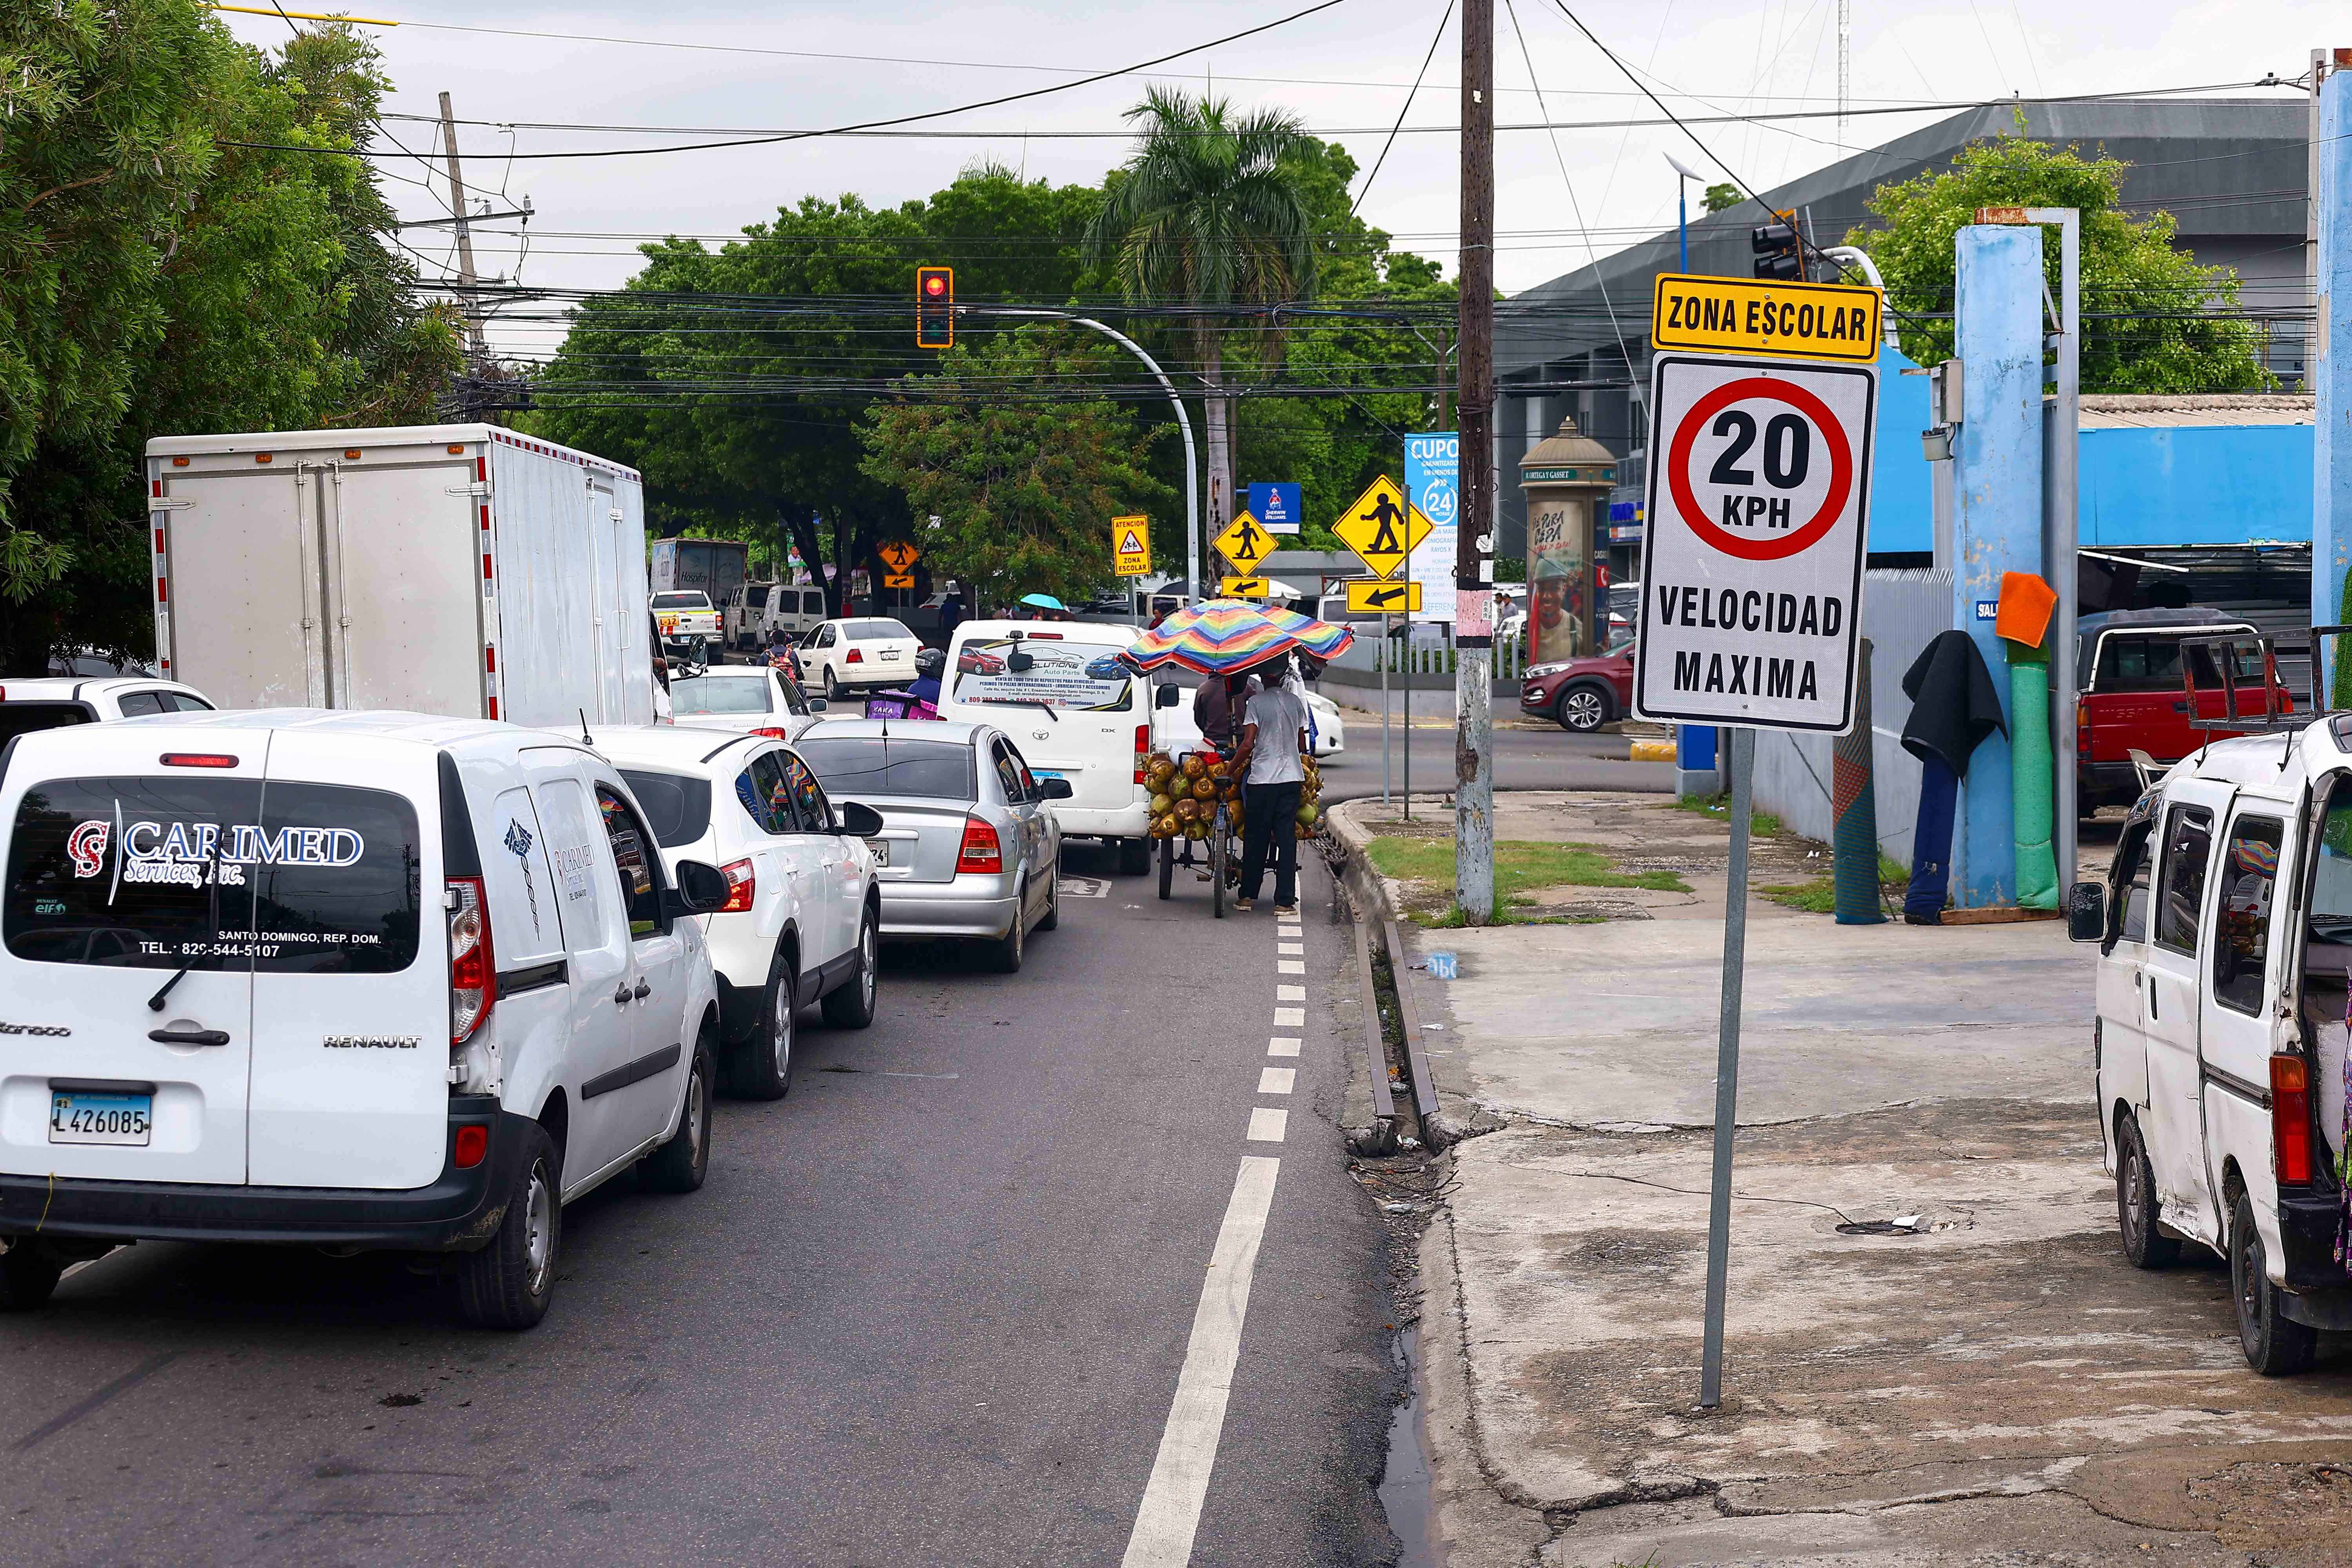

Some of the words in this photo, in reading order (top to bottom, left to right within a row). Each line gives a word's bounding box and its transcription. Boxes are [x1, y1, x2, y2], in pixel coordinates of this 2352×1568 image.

[1668, 296, 1736, 332] ZONA
[1746, 301, 1866, 341] ESCOLAR
[1709, 410, 1809, 489] 20
[1428, 493, 1451, 512] 24
[1722, 495, 1790, 528] KPH
[1659, 585, 1842, 637] VELOCIDAD
[1674, 651, 1817, 701] MAXIMA
[124, 821, 365, 866] CARIMED
[562, 844, 595, 873] CARIMED
[124, 859, 202, 889] Services,
[35, 904, 54, 913] elf
[182, 943, 280, 957] 829-544-5107
[218, 931, 258, 941] SANTO
[261, 932, 320, 944] DOMINGO,
[324, 934, 348, 943] REP.
[352, 934, 382, 944] DOM.
[323, 1035, 423, 1048] RENAULT
[55, 1109, 145, 1134] L426085
